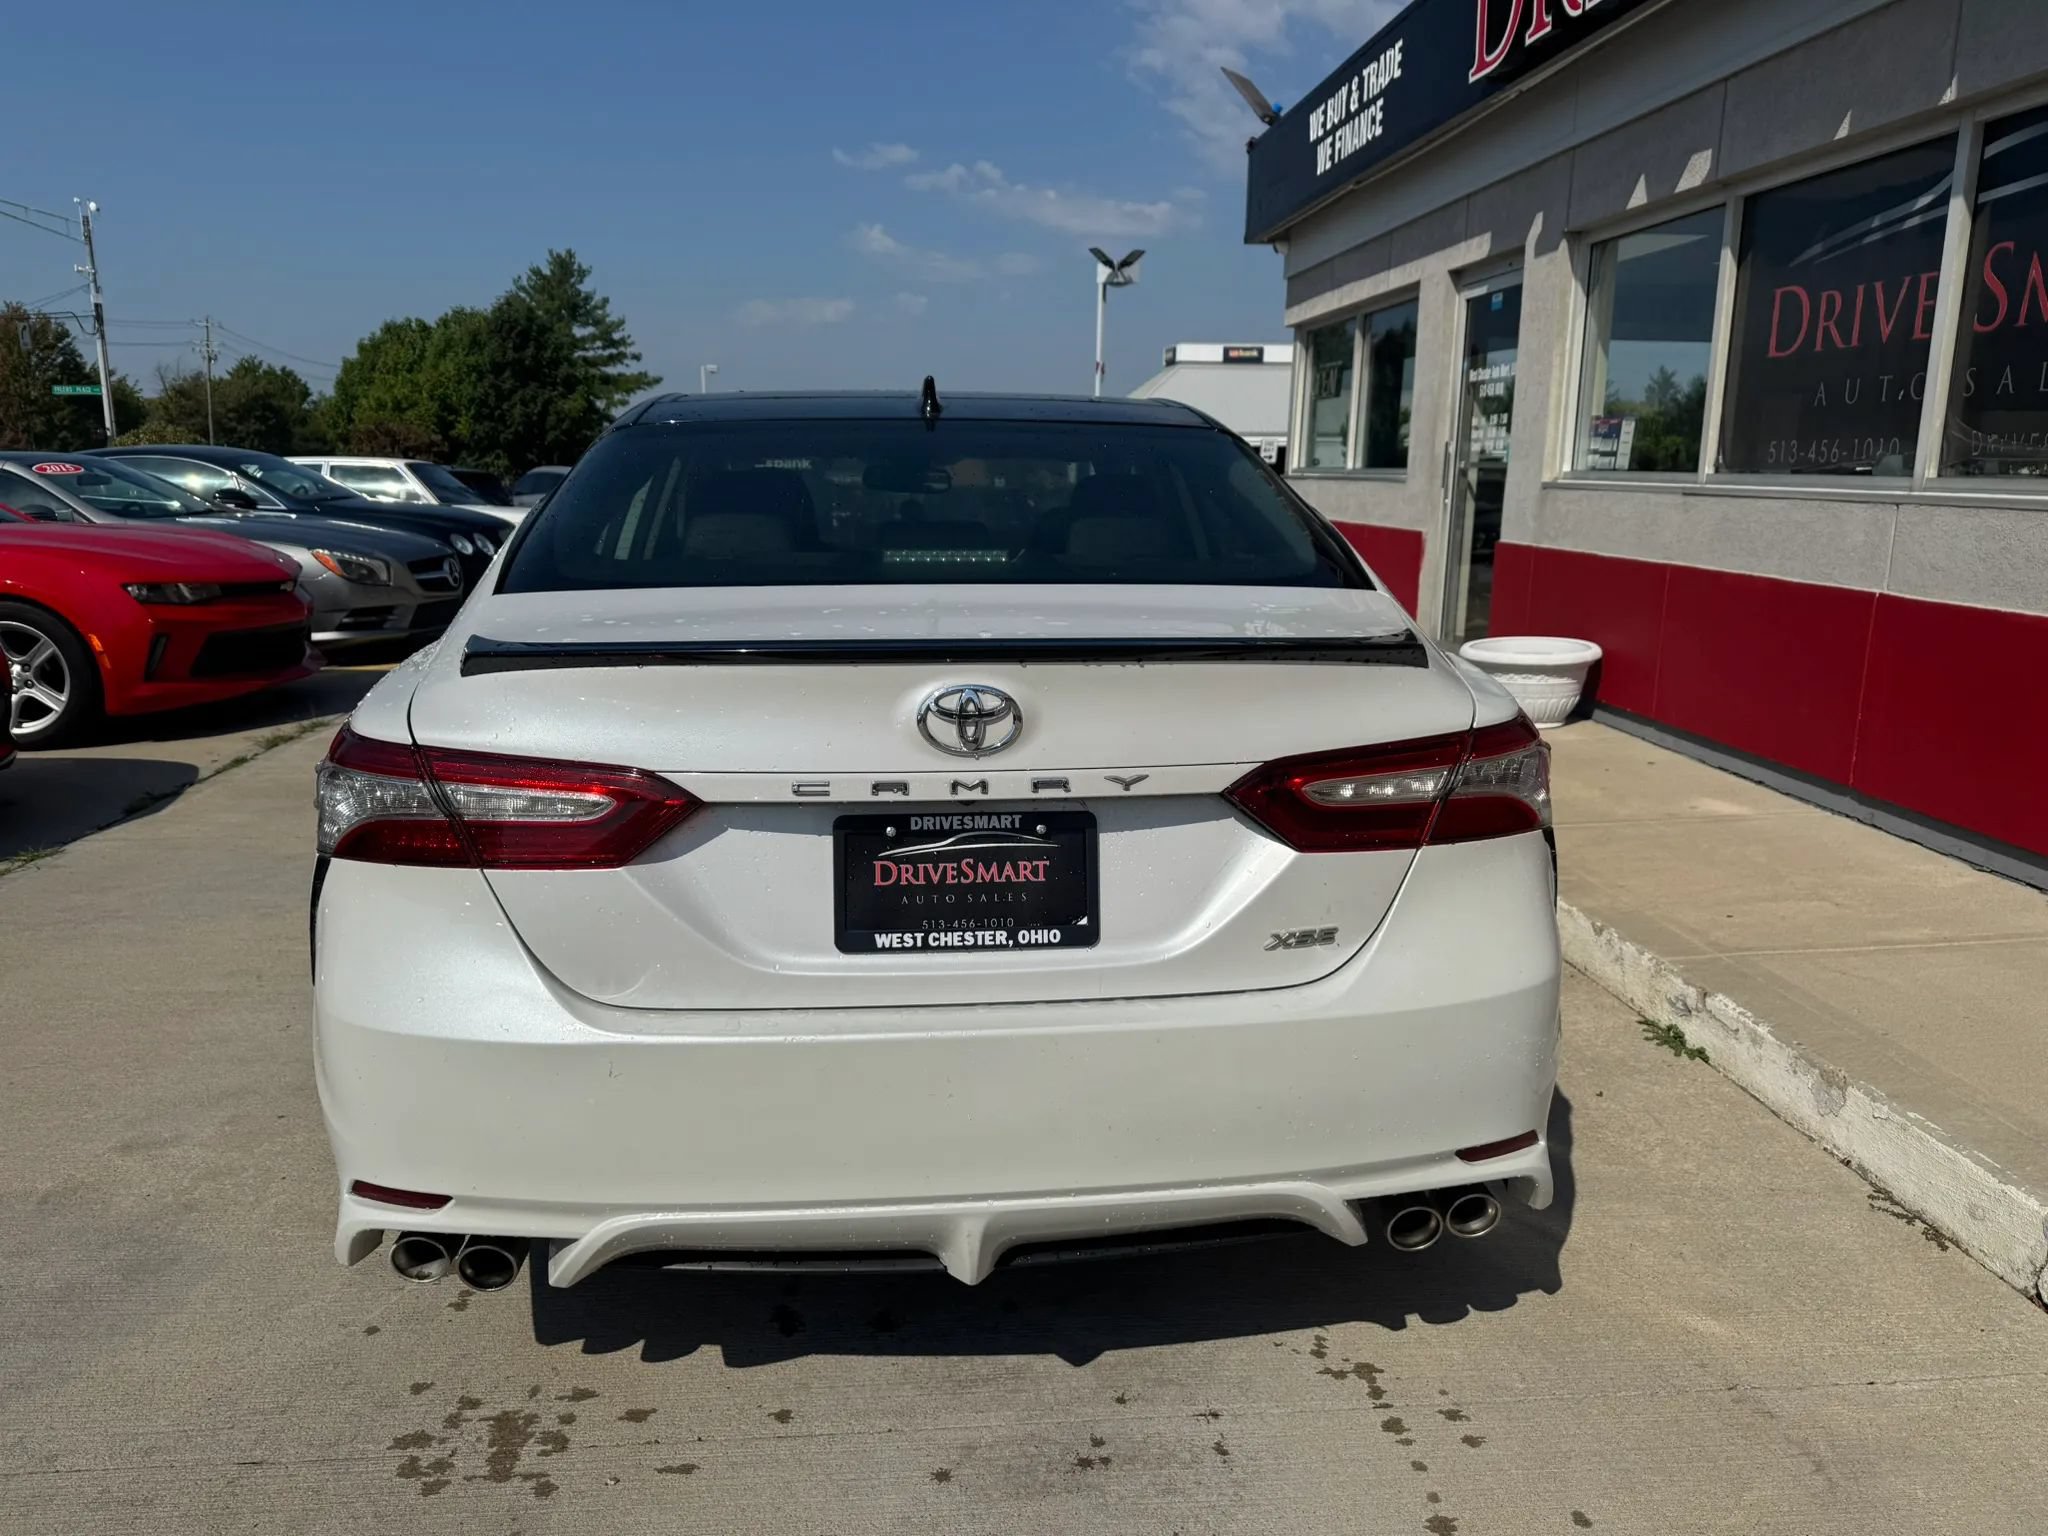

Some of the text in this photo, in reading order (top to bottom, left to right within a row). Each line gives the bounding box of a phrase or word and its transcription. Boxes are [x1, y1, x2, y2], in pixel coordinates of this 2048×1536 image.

[1309, 37, 1404, 143] WE BUY & TRADE
[1316, 97, 1385, 176] WE FINANCE
[42, 464, 75, 473] 2015
[791, 773, 1150, 797] CAMRY
[910, 814, 1022, 831] DRIVESMART
[901, 892, 1028, 905] AUTO SALES
[921, 917, 1015, 930] 513-456-1010
[874, 928, 1061, 948] WEST CHESTER, OHIO
[1263, 926, 1340, 951] XSE
